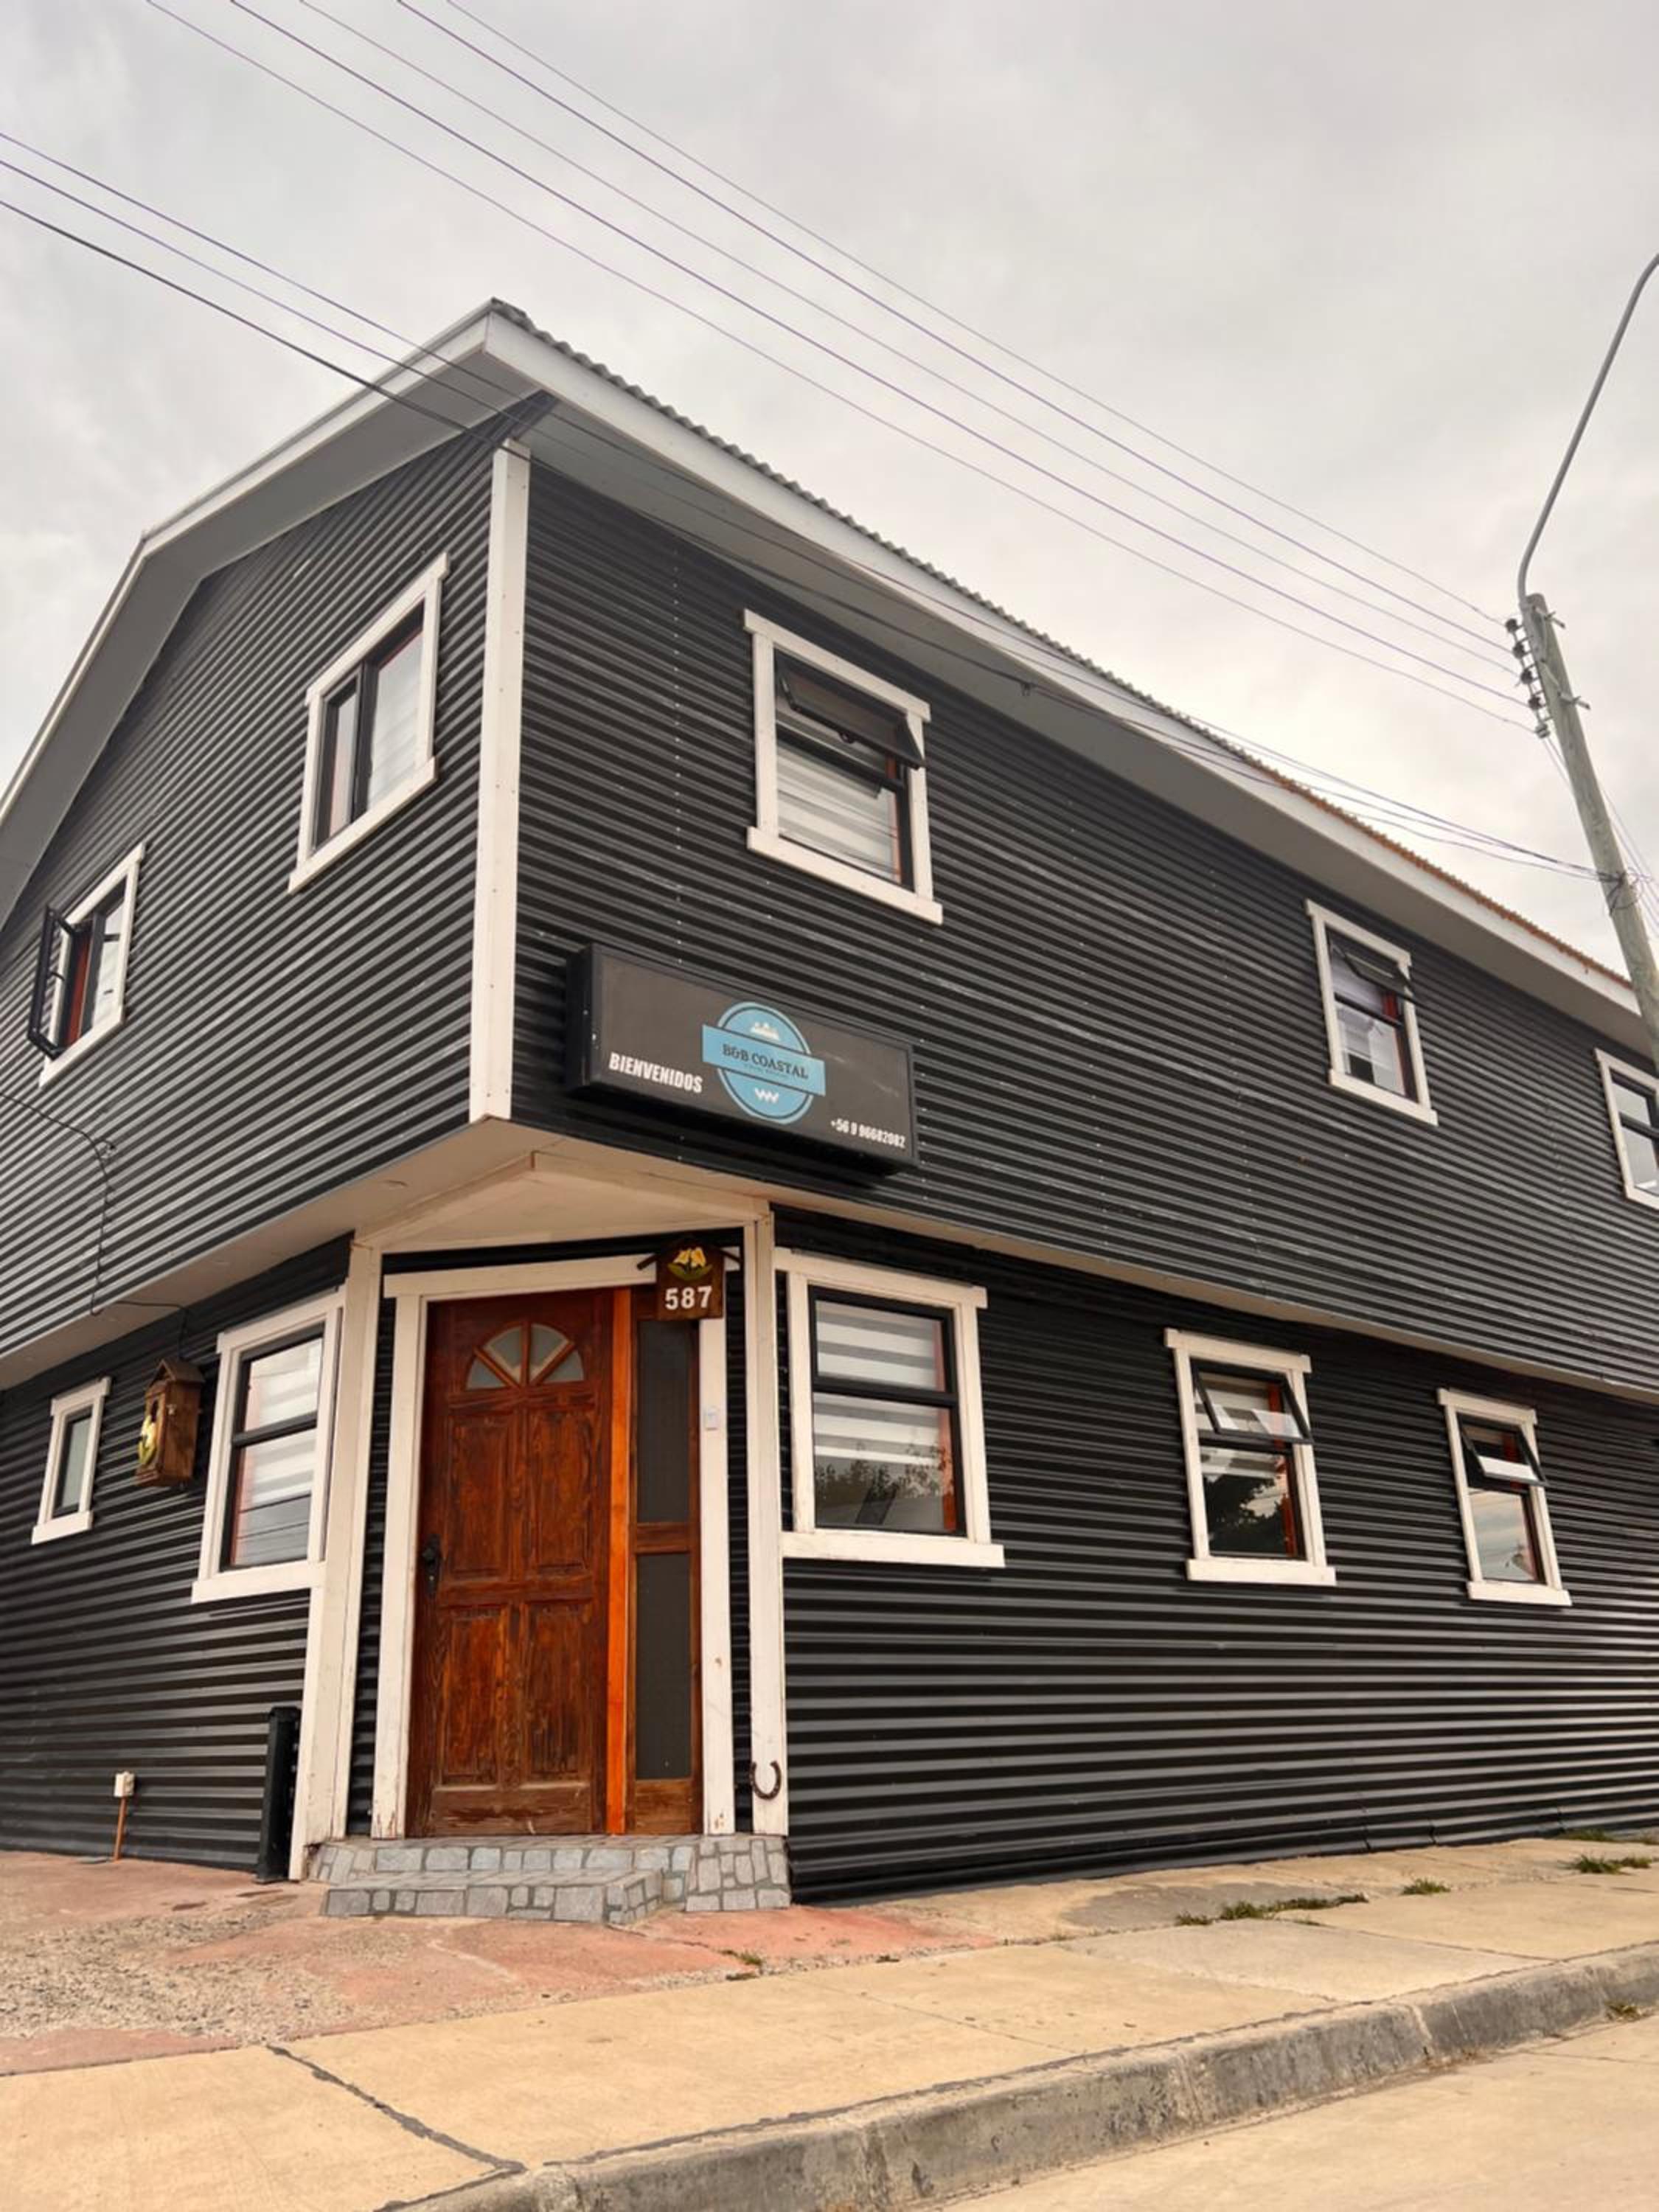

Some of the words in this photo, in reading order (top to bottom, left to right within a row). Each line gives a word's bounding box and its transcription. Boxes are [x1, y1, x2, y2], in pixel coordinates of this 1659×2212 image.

[608, 1051, 703, 1093] BIENVENIDOS
[723, 1043, 748, 1062] B&B
[751, 1053, 809, 1079] COASTAL
[830, 1118, 849, 1133] +56
[665, 1285, 712, 1310] 587
